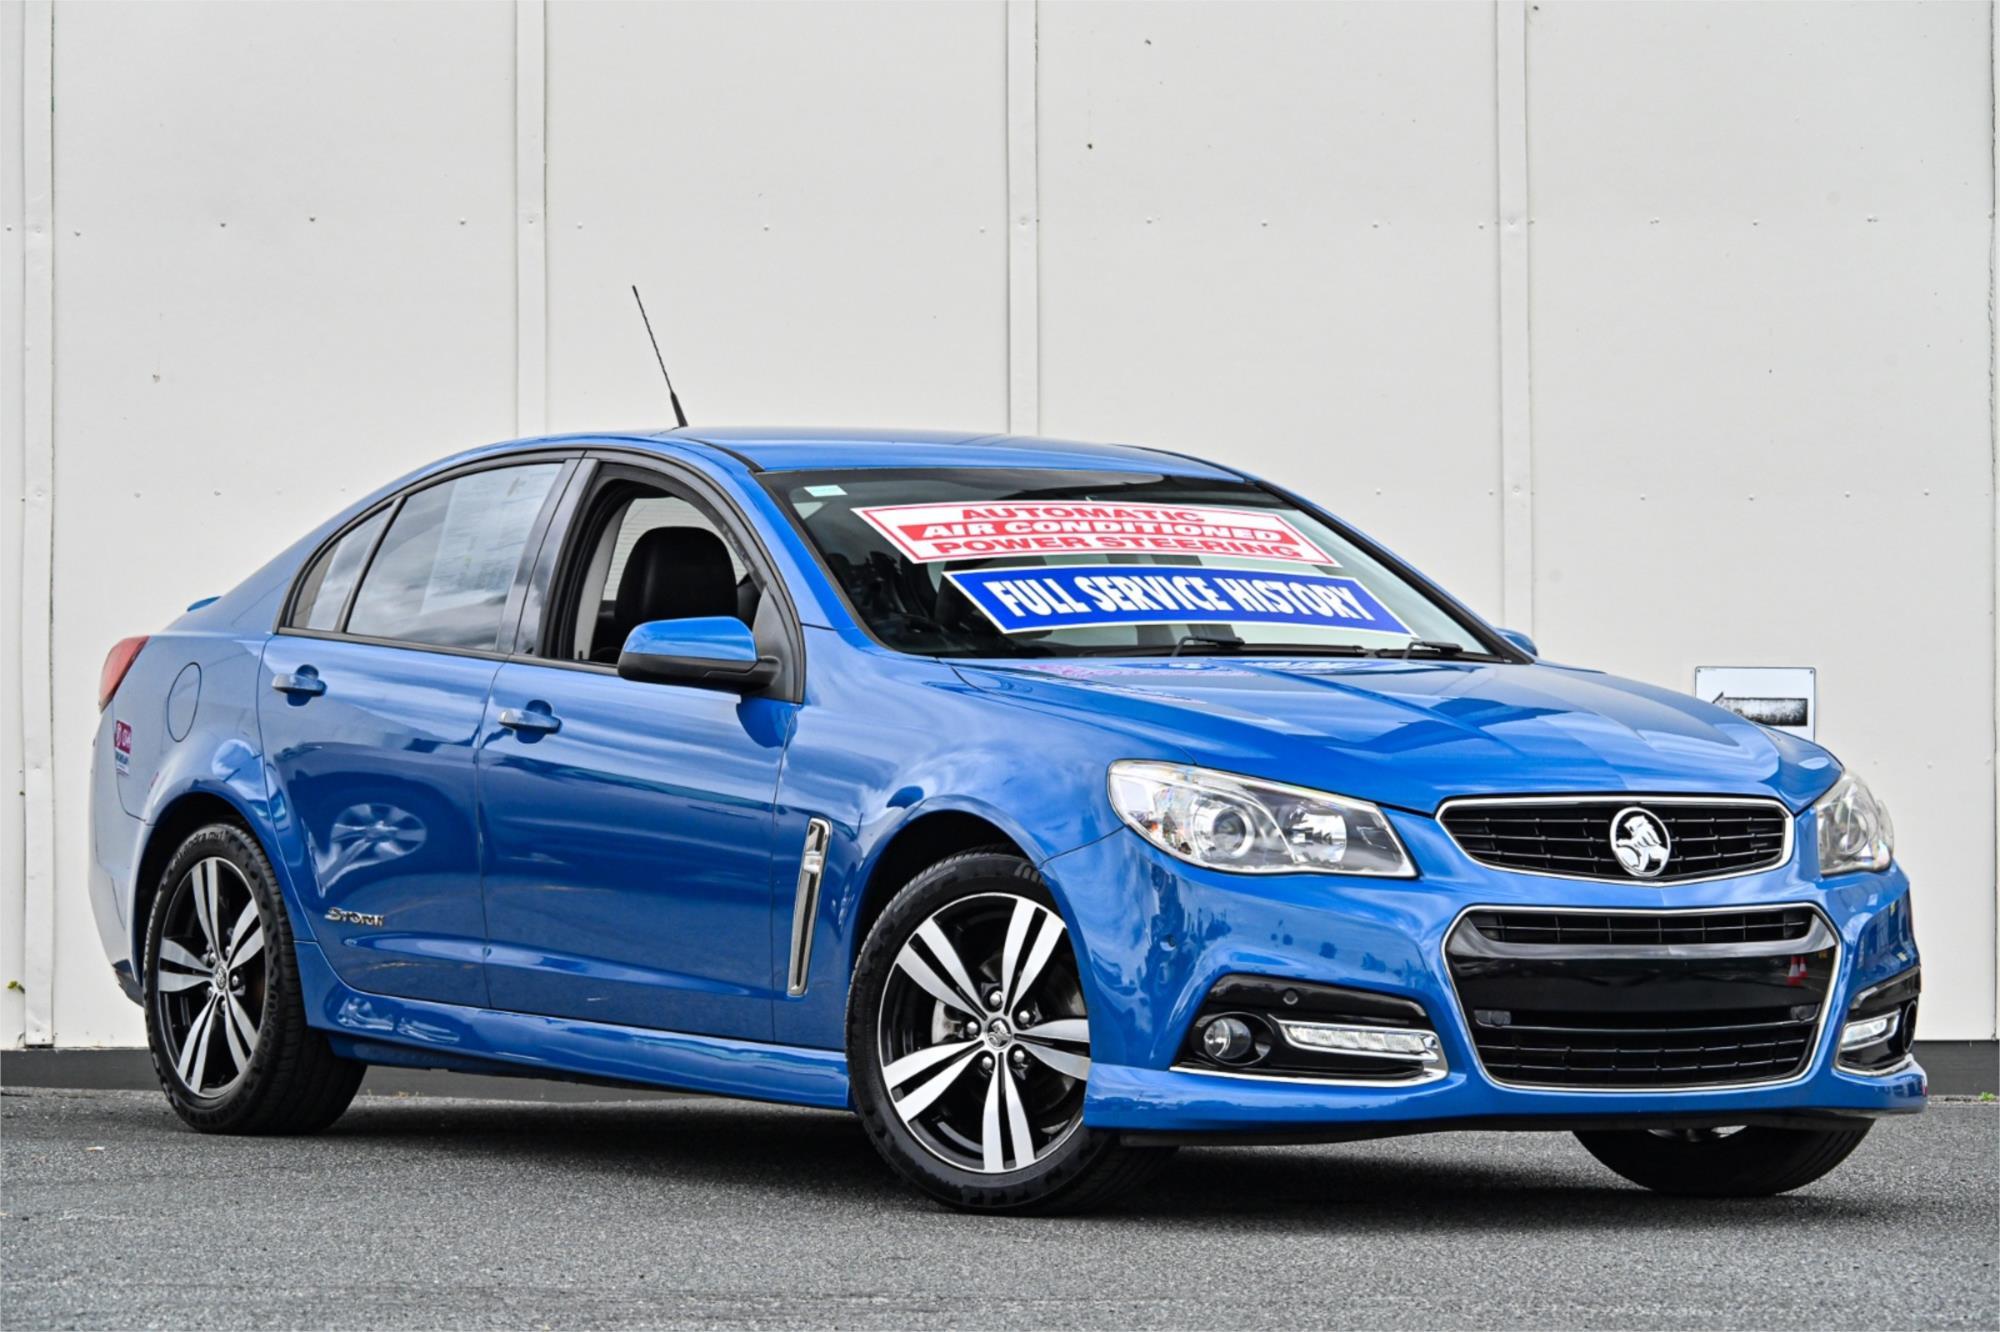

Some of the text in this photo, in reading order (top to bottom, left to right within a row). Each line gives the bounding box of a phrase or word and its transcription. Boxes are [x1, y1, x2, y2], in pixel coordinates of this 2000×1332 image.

[962, 508, 1204, 522] AUTOMATIC
[922, 521, 1282, 542] AIR CONDITIONED
[932, 536, 1303, 558] POWER STEERING
[982, 575, 1377, 622] FULL SERVICE HISTORY
